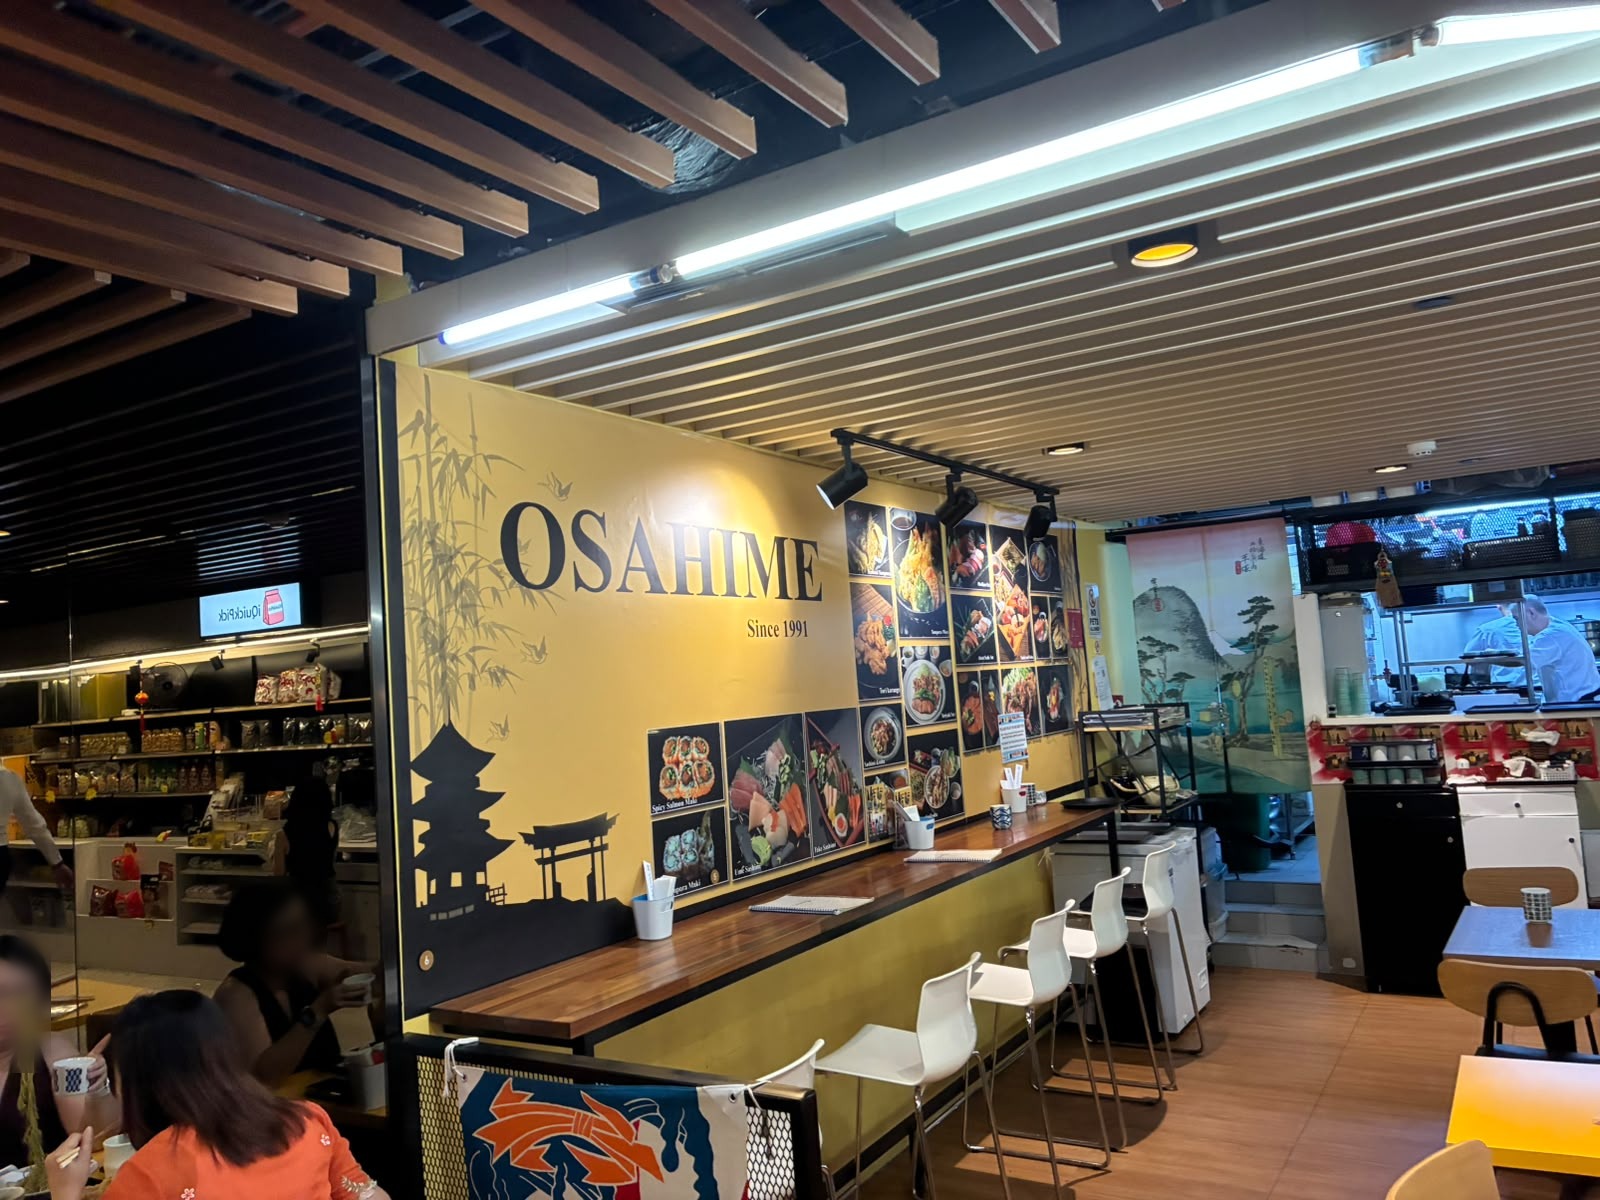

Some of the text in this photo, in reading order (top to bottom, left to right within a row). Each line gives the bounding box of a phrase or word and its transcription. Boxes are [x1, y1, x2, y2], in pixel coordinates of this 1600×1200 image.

[500, 501, 822, 602] OSAHIME
[747, 619, 808, 638] Since 1991
[666, 800, 685, 809] Salmon
[424, 954, 430, 966] 6
